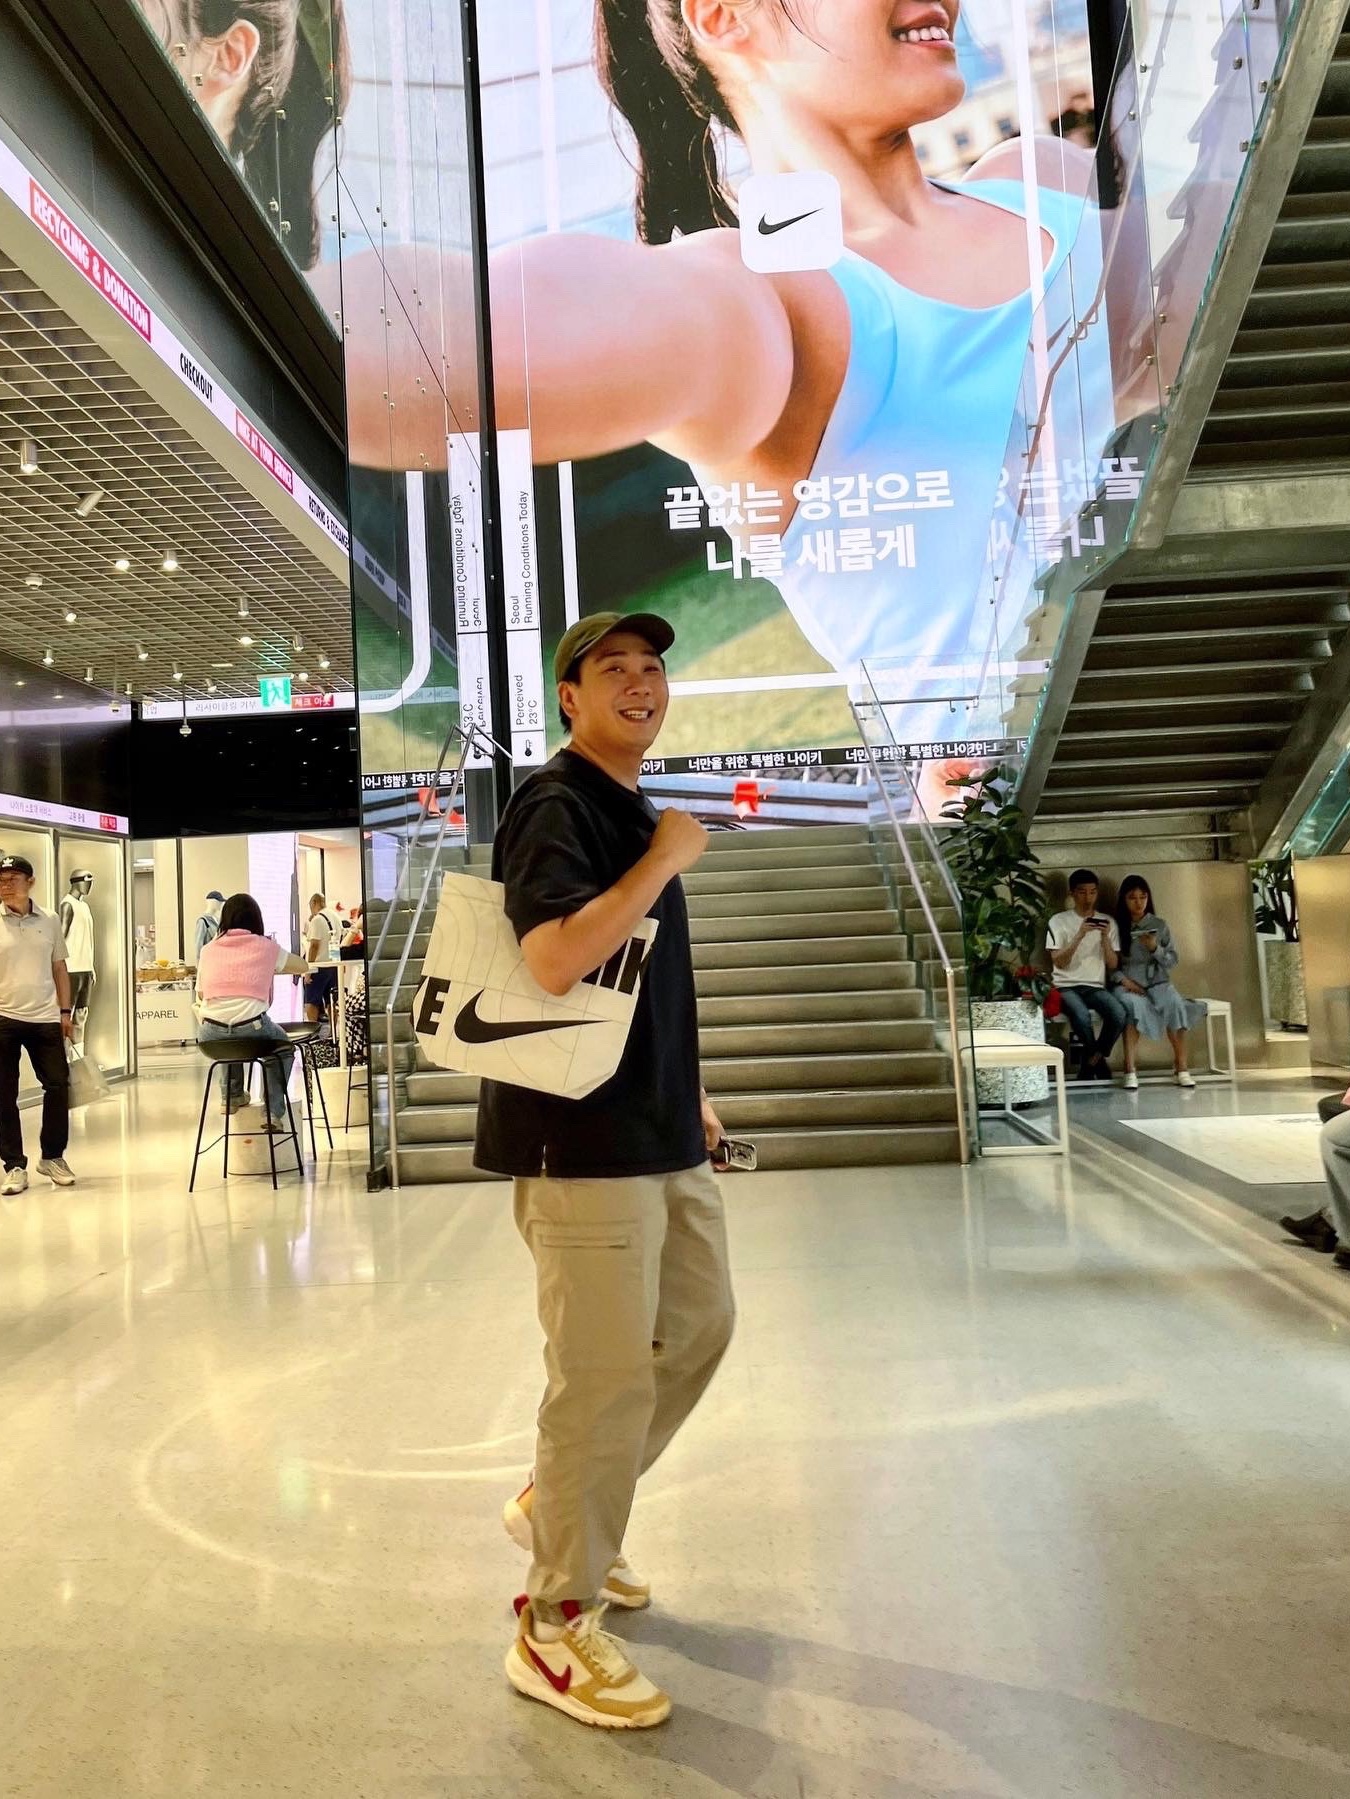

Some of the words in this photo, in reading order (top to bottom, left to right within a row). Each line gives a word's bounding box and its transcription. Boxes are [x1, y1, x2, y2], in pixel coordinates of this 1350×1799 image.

[33, 190, 90, 270] RECYCLING
[92, 255, 102, 284] &
[103, 270, 149, 332] DONATION
[519, 491, 529, 522] Today
[663, 482, 783, 530] 끝없는
[792, 470, 954, 521] 영감으로
[520, 523, 531, 578] Conditions
[705, 533, 786, 579] 나를
[796, 524, 916, 573] 새롭게
[510, 595, 520, 624] Seoul
[524, 582, 534, 623] Running
[514, 674, 525, 725] Perceived
[528, 699, 538, 724] 23°C
[688, 758, 723, 771] 너만을
[725, 756, 749, 769] 위한
[750, 753, 786, 768] 특별한
[787, 751, 822, 765] 나이키
[909, 744, 944, 759] 특별한
[135, 1010, 179, 1020] APPAREL
[415, 976, 451, 1036] E
